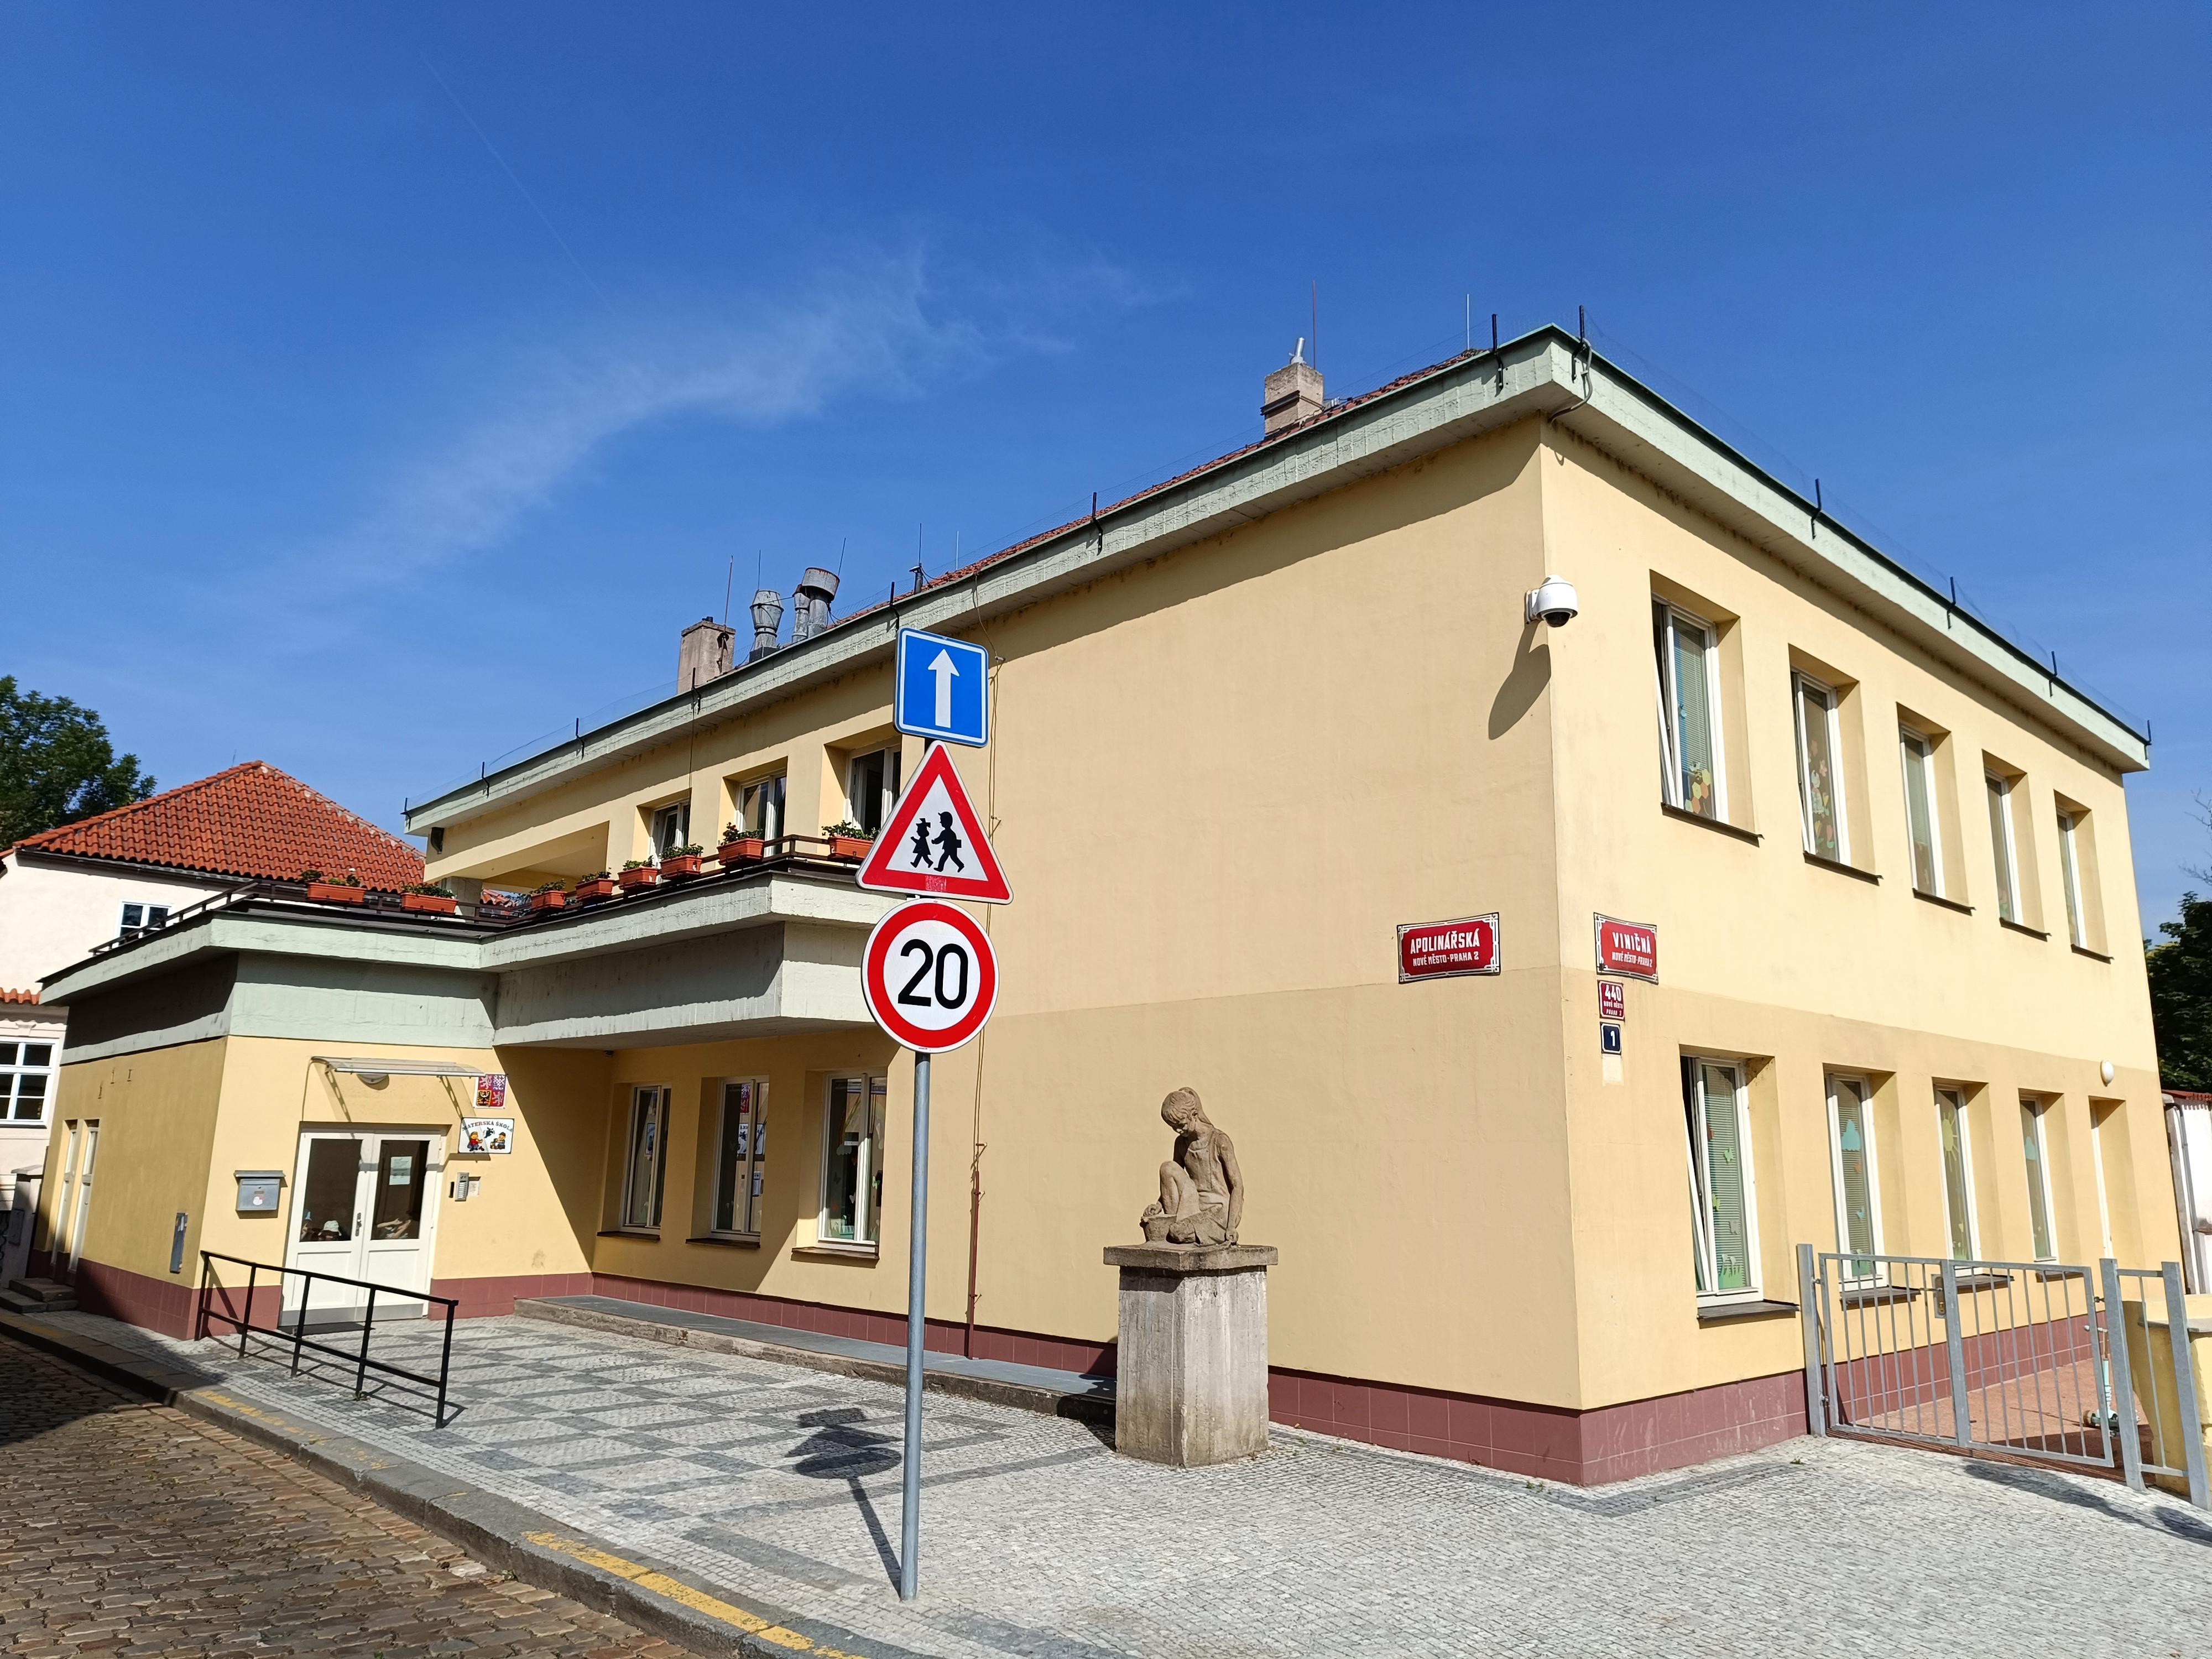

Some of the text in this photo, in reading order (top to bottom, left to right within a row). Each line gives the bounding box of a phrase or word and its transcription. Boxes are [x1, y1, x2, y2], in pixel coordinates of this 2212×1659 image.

[1410, 928, 1480, 954] APOLINÁŘSKÁ
[1612, 932, 1651, 954] VINIČNÁ
[1413, 954, 1427, 967] NOVÉ
[1473, 951, 1479, 960] 2
[1611, 951, 1624, 962] NOVÉ
[898, 939, 968, 1009] 20
[1605, 984, 1622, 1001] 440
[1610, 1030, 1615, 1046] 1
